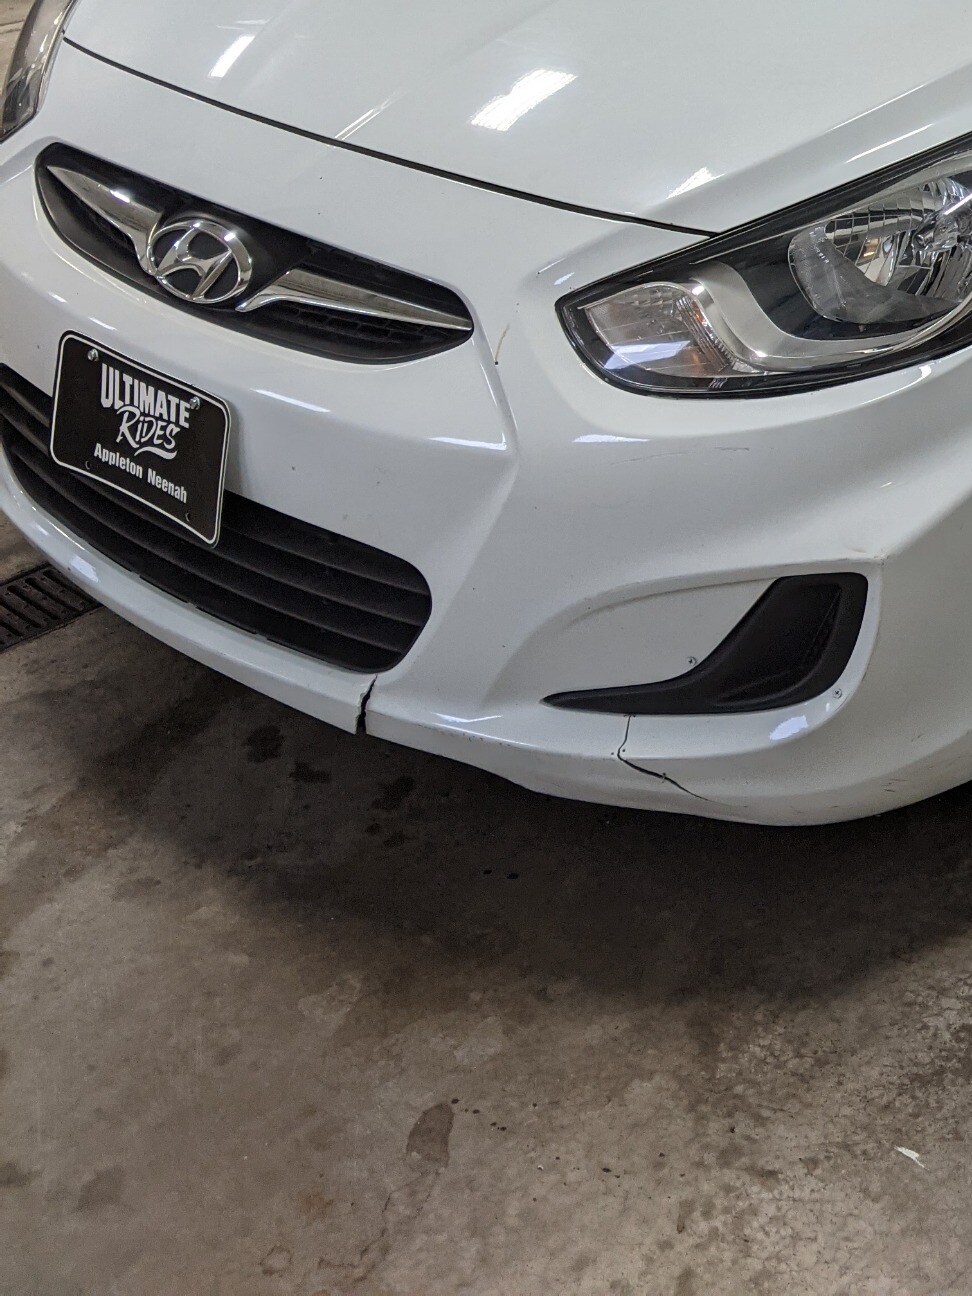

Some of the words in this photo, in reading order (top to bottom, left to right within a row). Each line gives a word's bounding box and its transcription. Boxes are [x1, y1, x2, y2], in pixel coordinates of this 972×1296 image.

[100, 363, 190, 429] ULTIMATE
[94, 442, 144, 479] Appleton
[147, 468, 188, 504] Neenah
